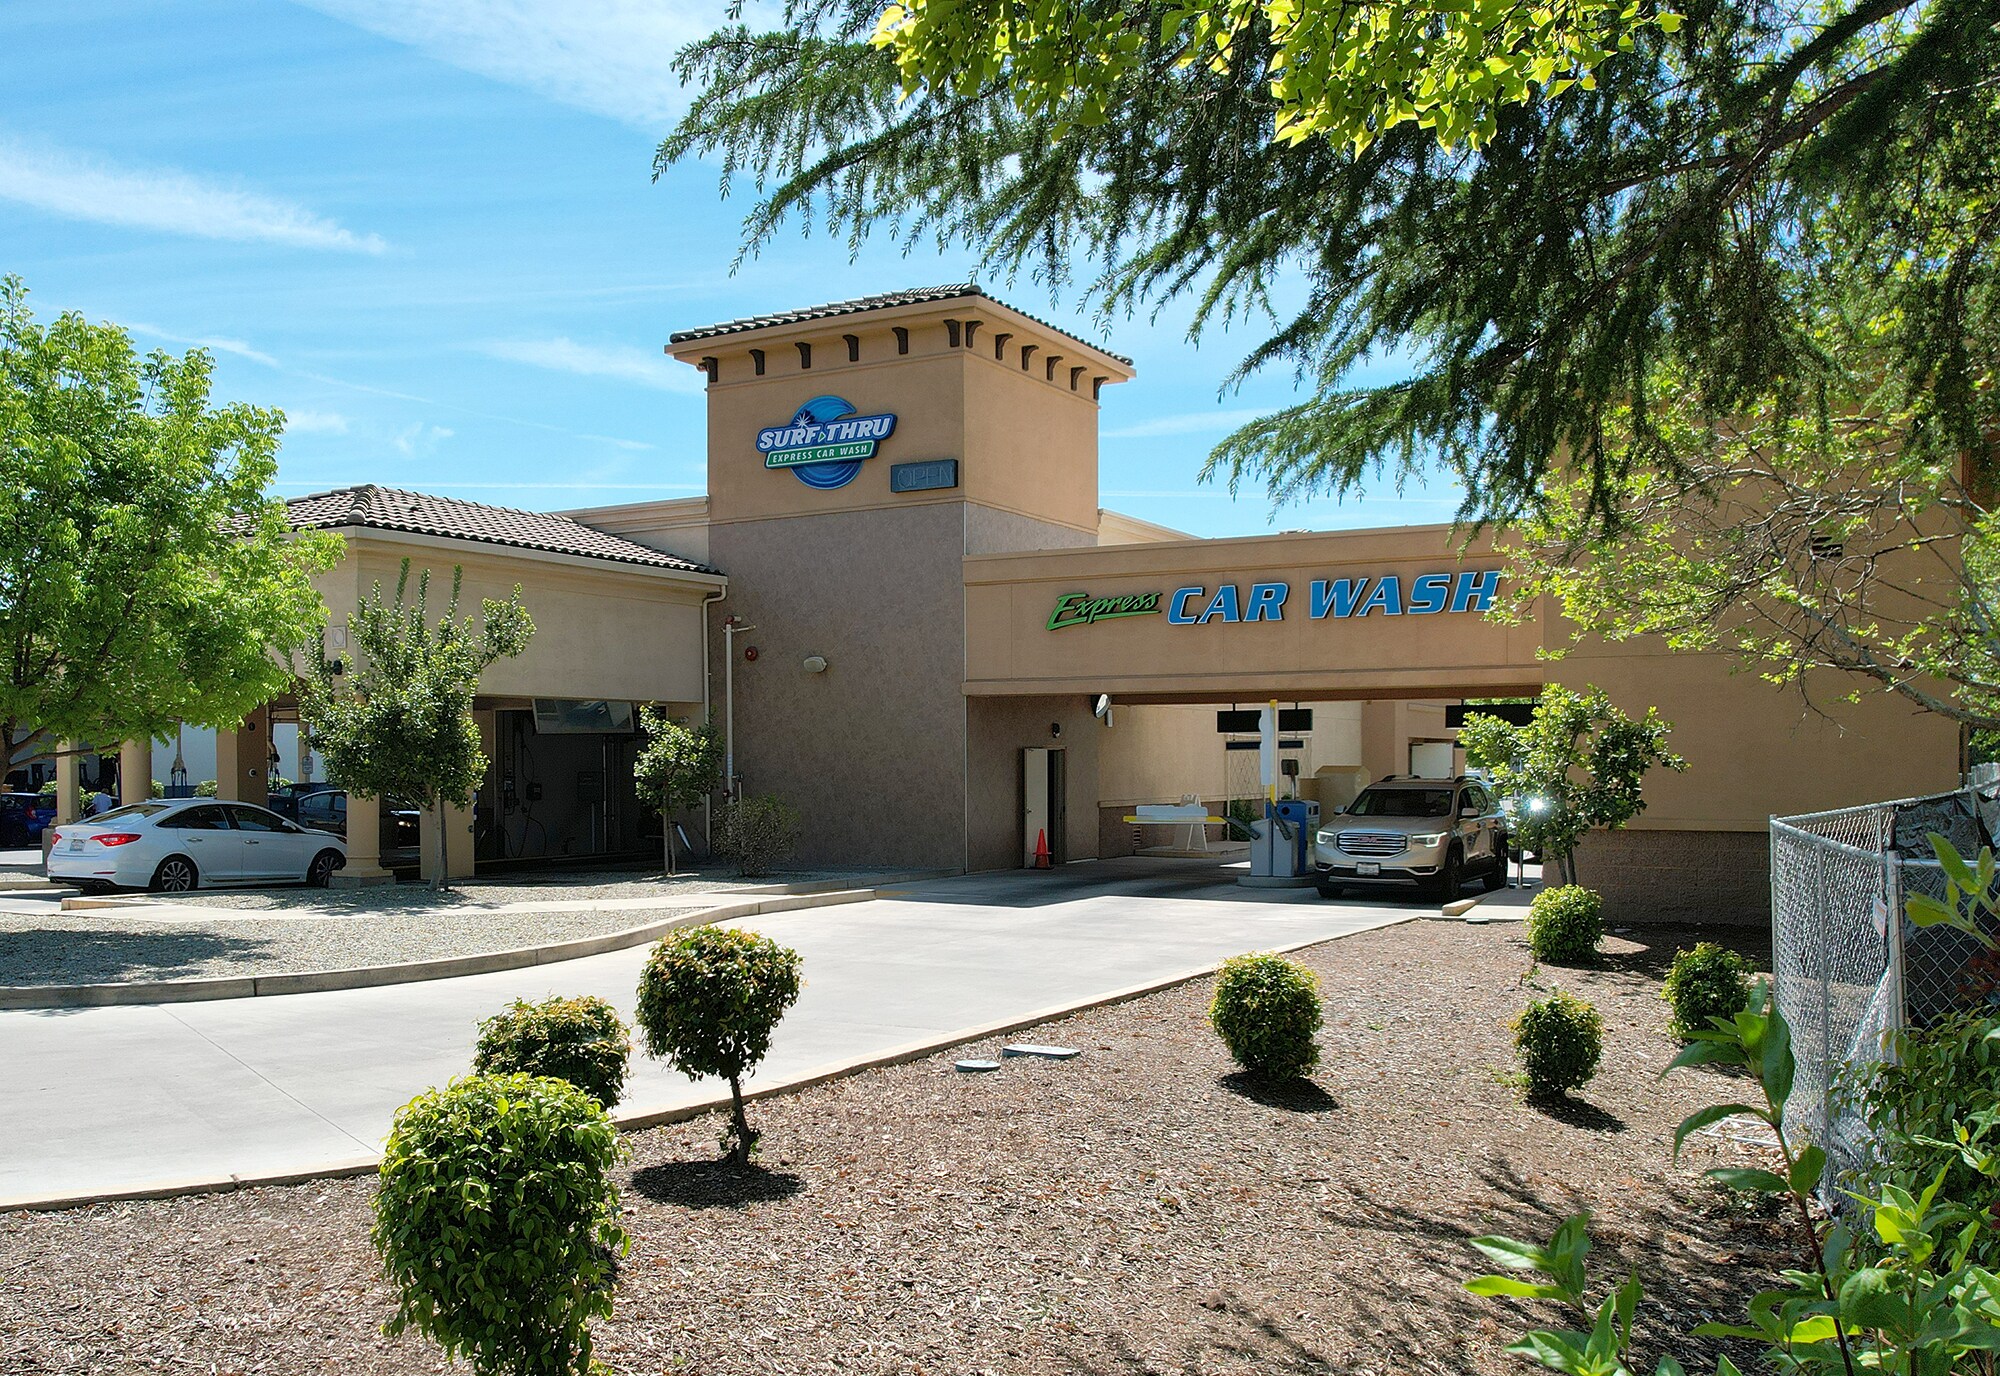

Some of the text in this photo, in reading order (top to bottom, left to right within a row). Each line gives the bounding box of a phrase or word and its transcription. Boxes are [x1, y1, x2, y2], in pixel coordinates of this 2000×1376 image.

[759, 417, 891, 449] SURF THRU
[772, 445, 868, 463] EXPRESS CAR WASH
[897, 464, 953, 489] OPEN
[1045, 571, 1501, 630] Express CAR WASH
